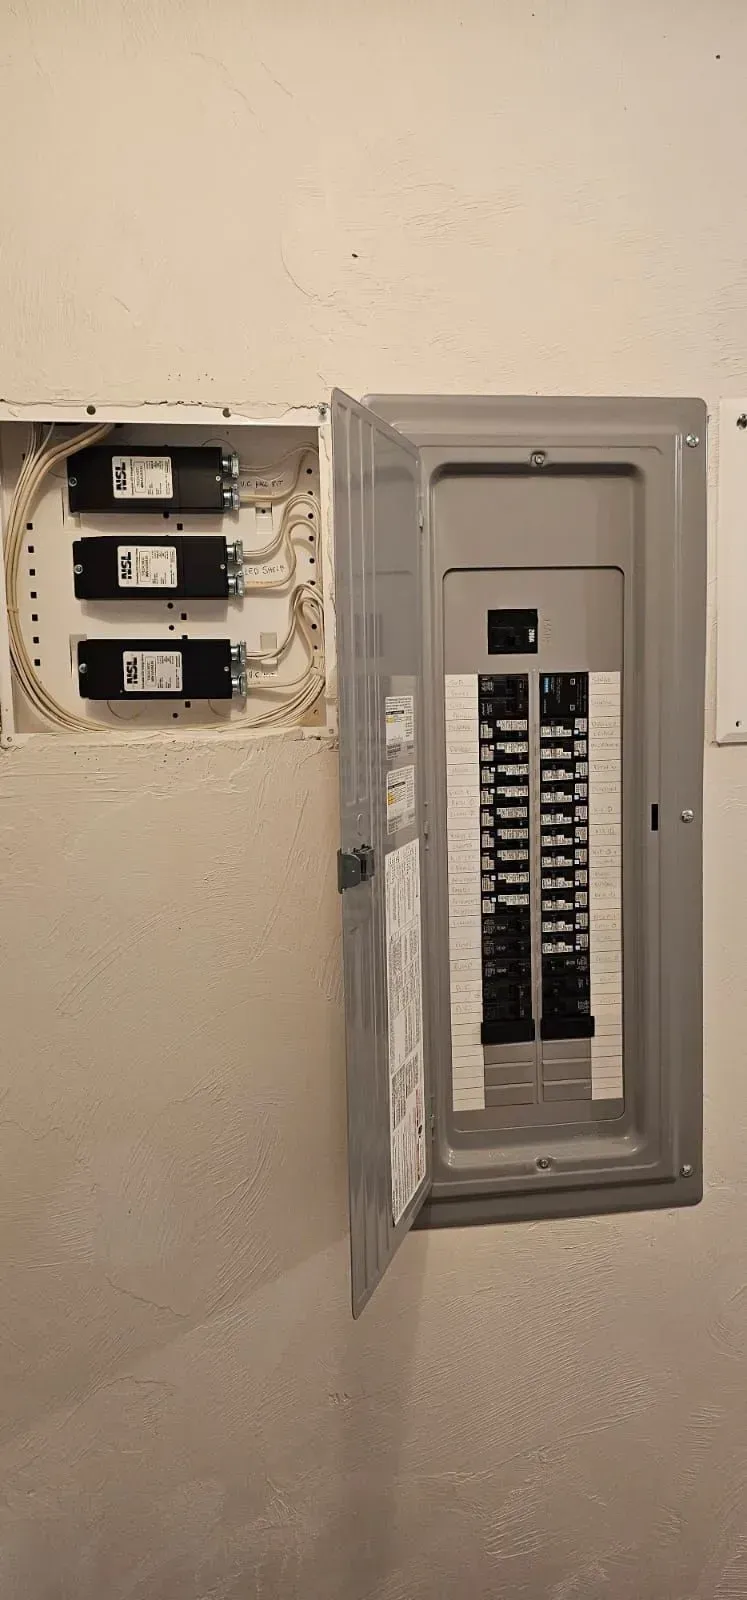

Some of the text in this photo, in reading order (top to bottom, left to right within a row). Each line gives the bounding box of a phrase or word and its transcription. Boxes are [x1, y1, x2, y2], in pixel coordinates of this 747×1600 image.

[115, 462, 127, 491] NSL
[121, 552, 132, 579] NSL
[126, 657, 138, 684] NSL
